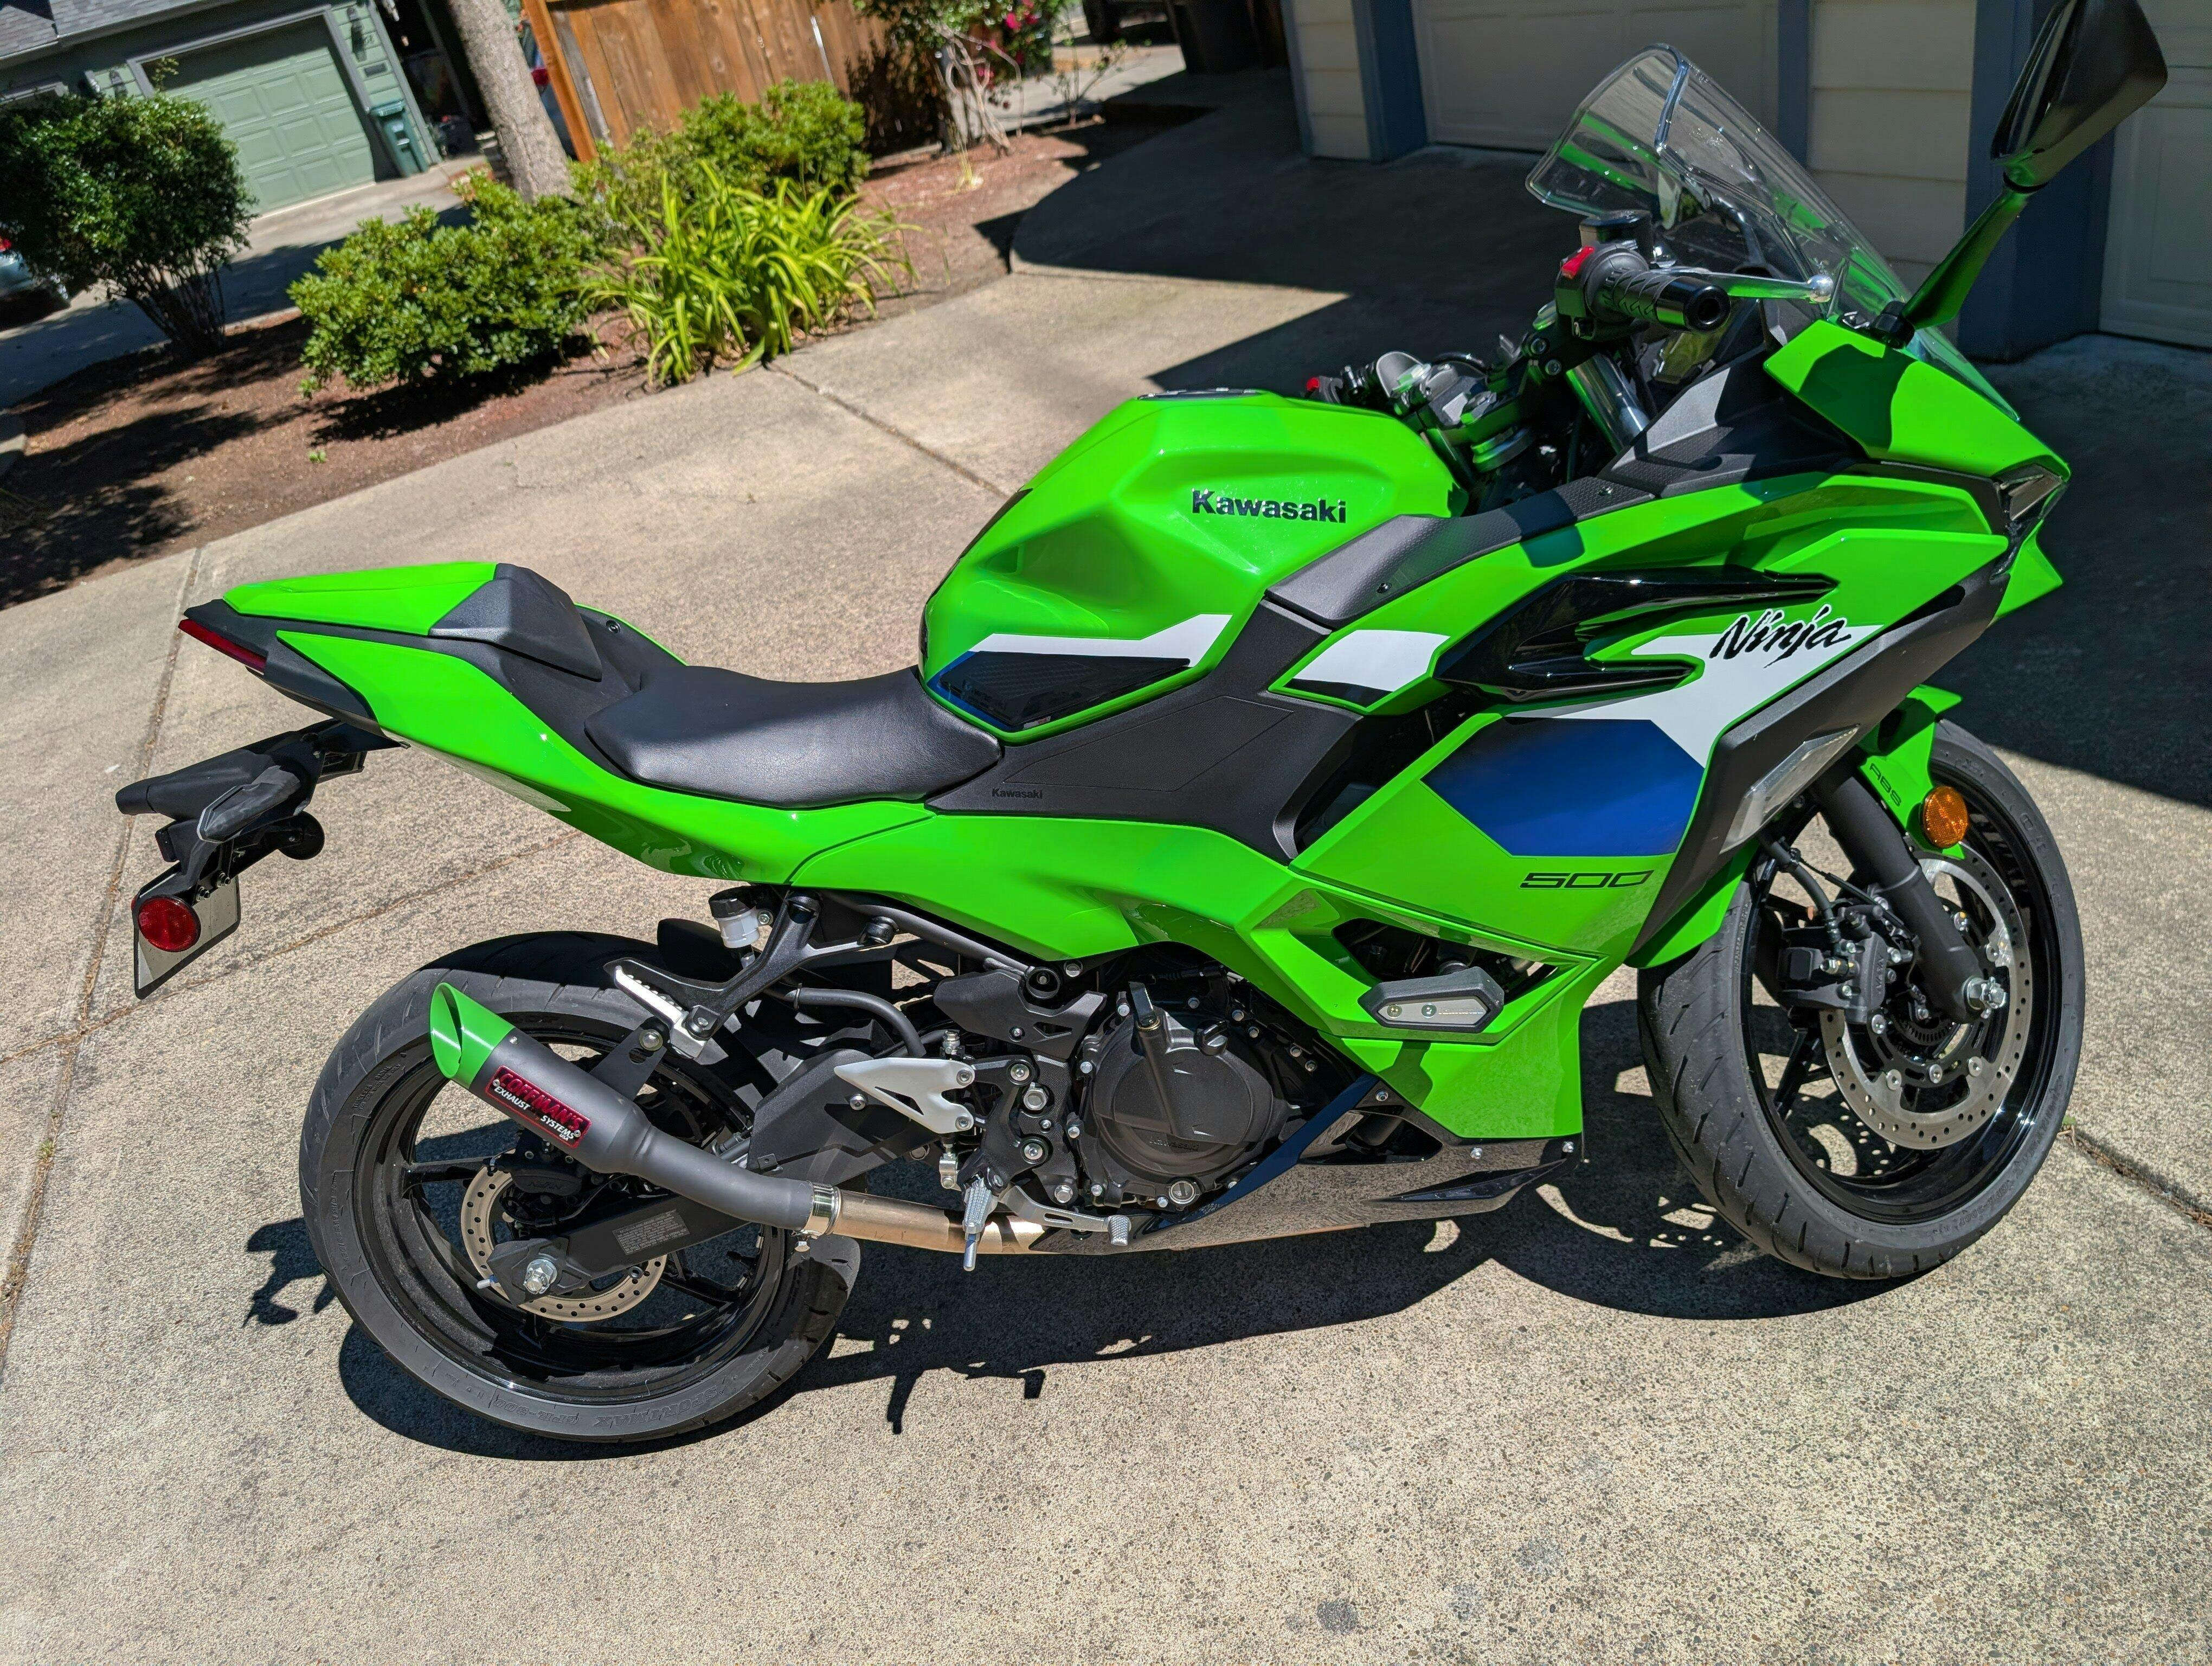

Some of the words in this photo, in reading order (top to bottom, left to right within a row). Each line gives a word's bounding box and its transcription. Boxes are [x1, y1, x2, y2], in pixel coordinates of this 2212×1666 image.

[1192, 489, 1346, 523] Kawasaki
[1709, 606, 1851, 669] Ninja
[992, 788, 1043, 799] Kawasaki
[1869, 763, 1901, 807] ABS
[1519, 869, 1655, 888] 500
[494, 1086, 531, 1111] EXHAUST
[540, 1115, 575, 1139] SYSTEMS
[492, 1398, 581, 1426] GPR-300
[593, 1385, 718, 1428] SPORTMAX
